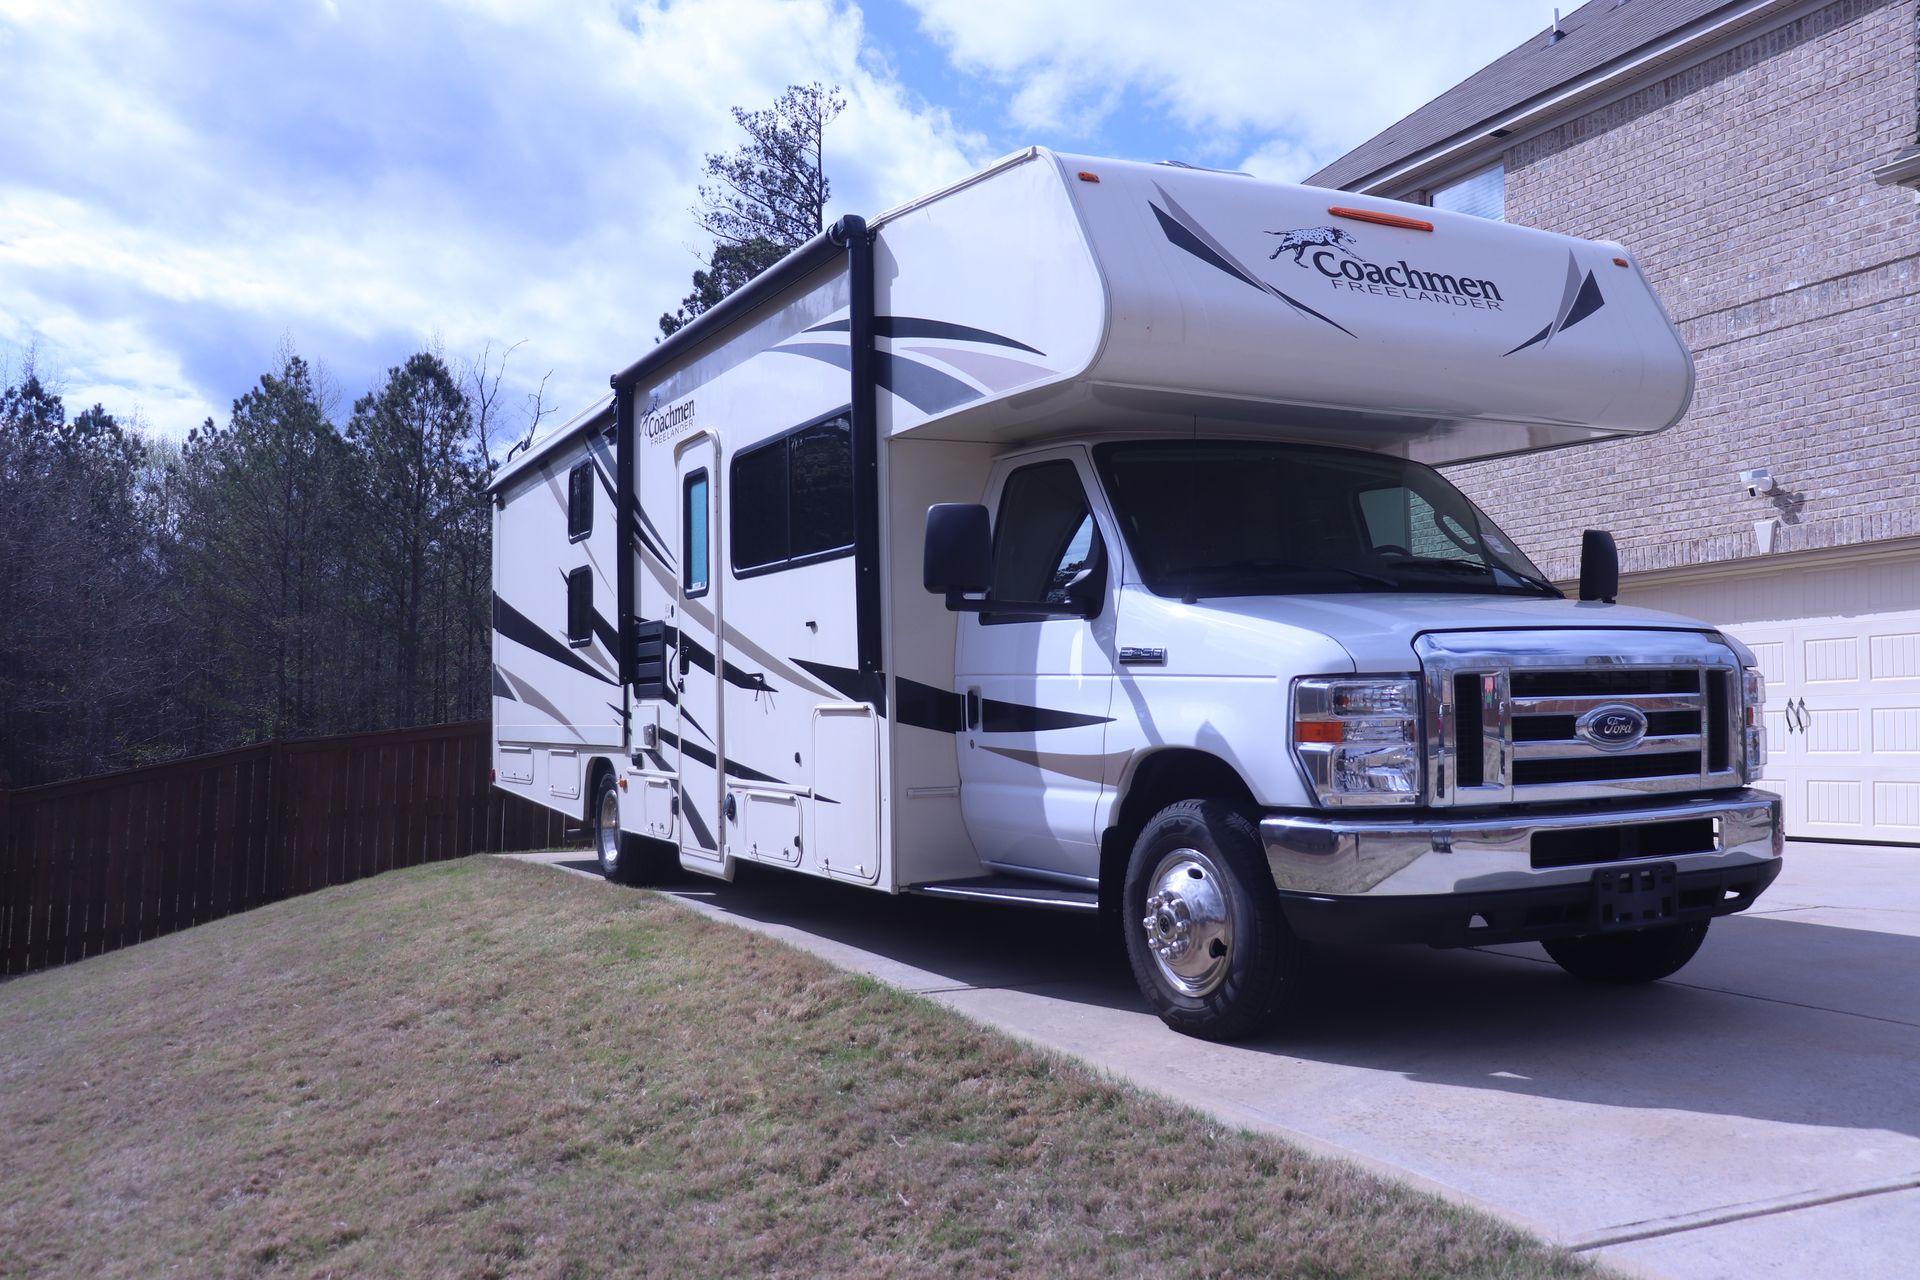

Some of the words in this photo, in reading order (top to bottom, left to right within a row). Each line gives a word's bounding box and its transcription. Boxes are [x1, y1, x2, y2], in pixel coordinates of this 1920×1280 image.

[1312, 251, 1505, 302] Coachmen
[1331, 279, 1503, 312] FREELANDER
[649, 400, 695, 438] Coachmen
[651, 419, 694, 448] FREELANDER
[1604, 716, 1633, 734] Ford
